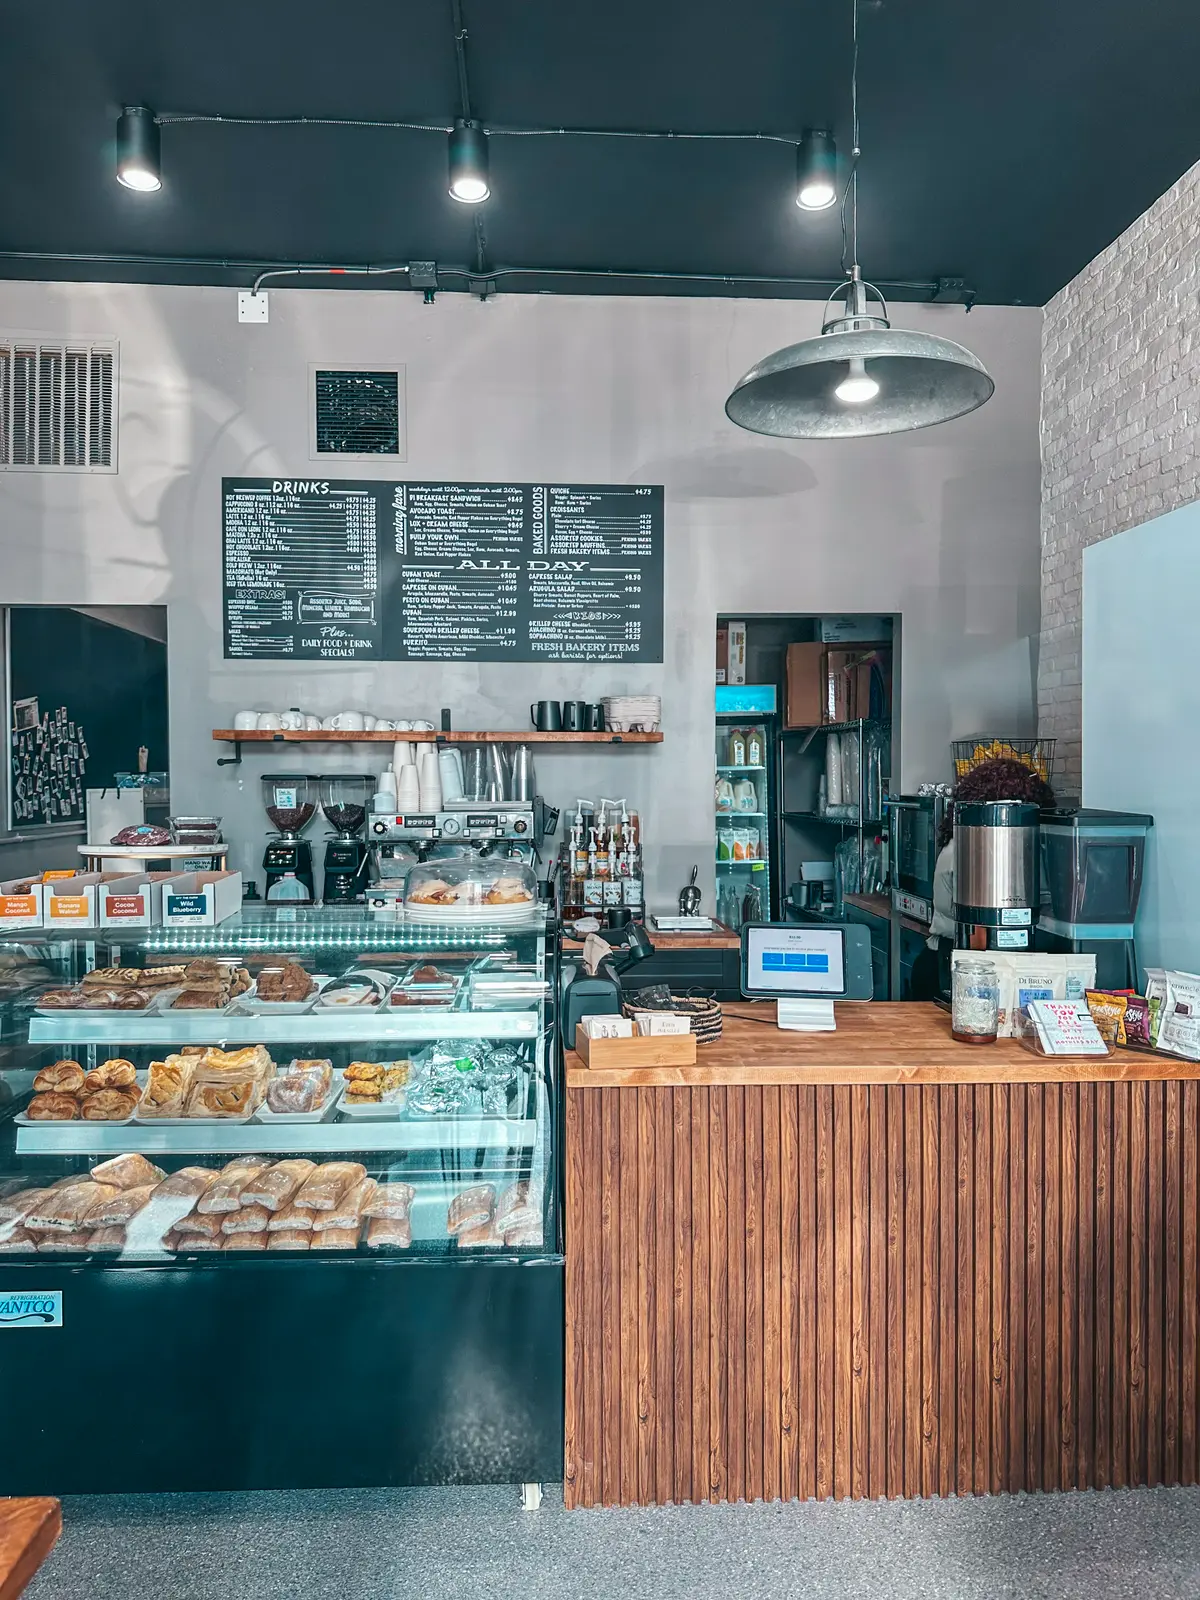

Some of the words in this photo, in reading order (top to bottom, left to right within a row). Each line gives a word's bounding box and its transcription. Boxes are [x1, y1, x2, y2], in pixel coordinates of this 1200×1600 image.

[272, 481, 330, 494] DRINKS
[392, 486, 407, 510] fare
[532, 486, 543, 520] GOODS
[392, 509, 407, 554] morning
[532, 522, 543, 554] BAKED
[456, 560, 520, 570] ALL
[526, 561, 589, 571] DAY
[236, 588, 286, 600] EXTRAS!
[302, 639, 322, 647] DAILY
[350, 640, 373, 648] DRINK
[532, 643, 563, 651] FRESH
[565, 643, 606, 651] BAKERY
[609, 644, 640, 652] ITEMS
[320, 648, 354, 656] SPECIALS!
[586, 652, 597, 660] for
